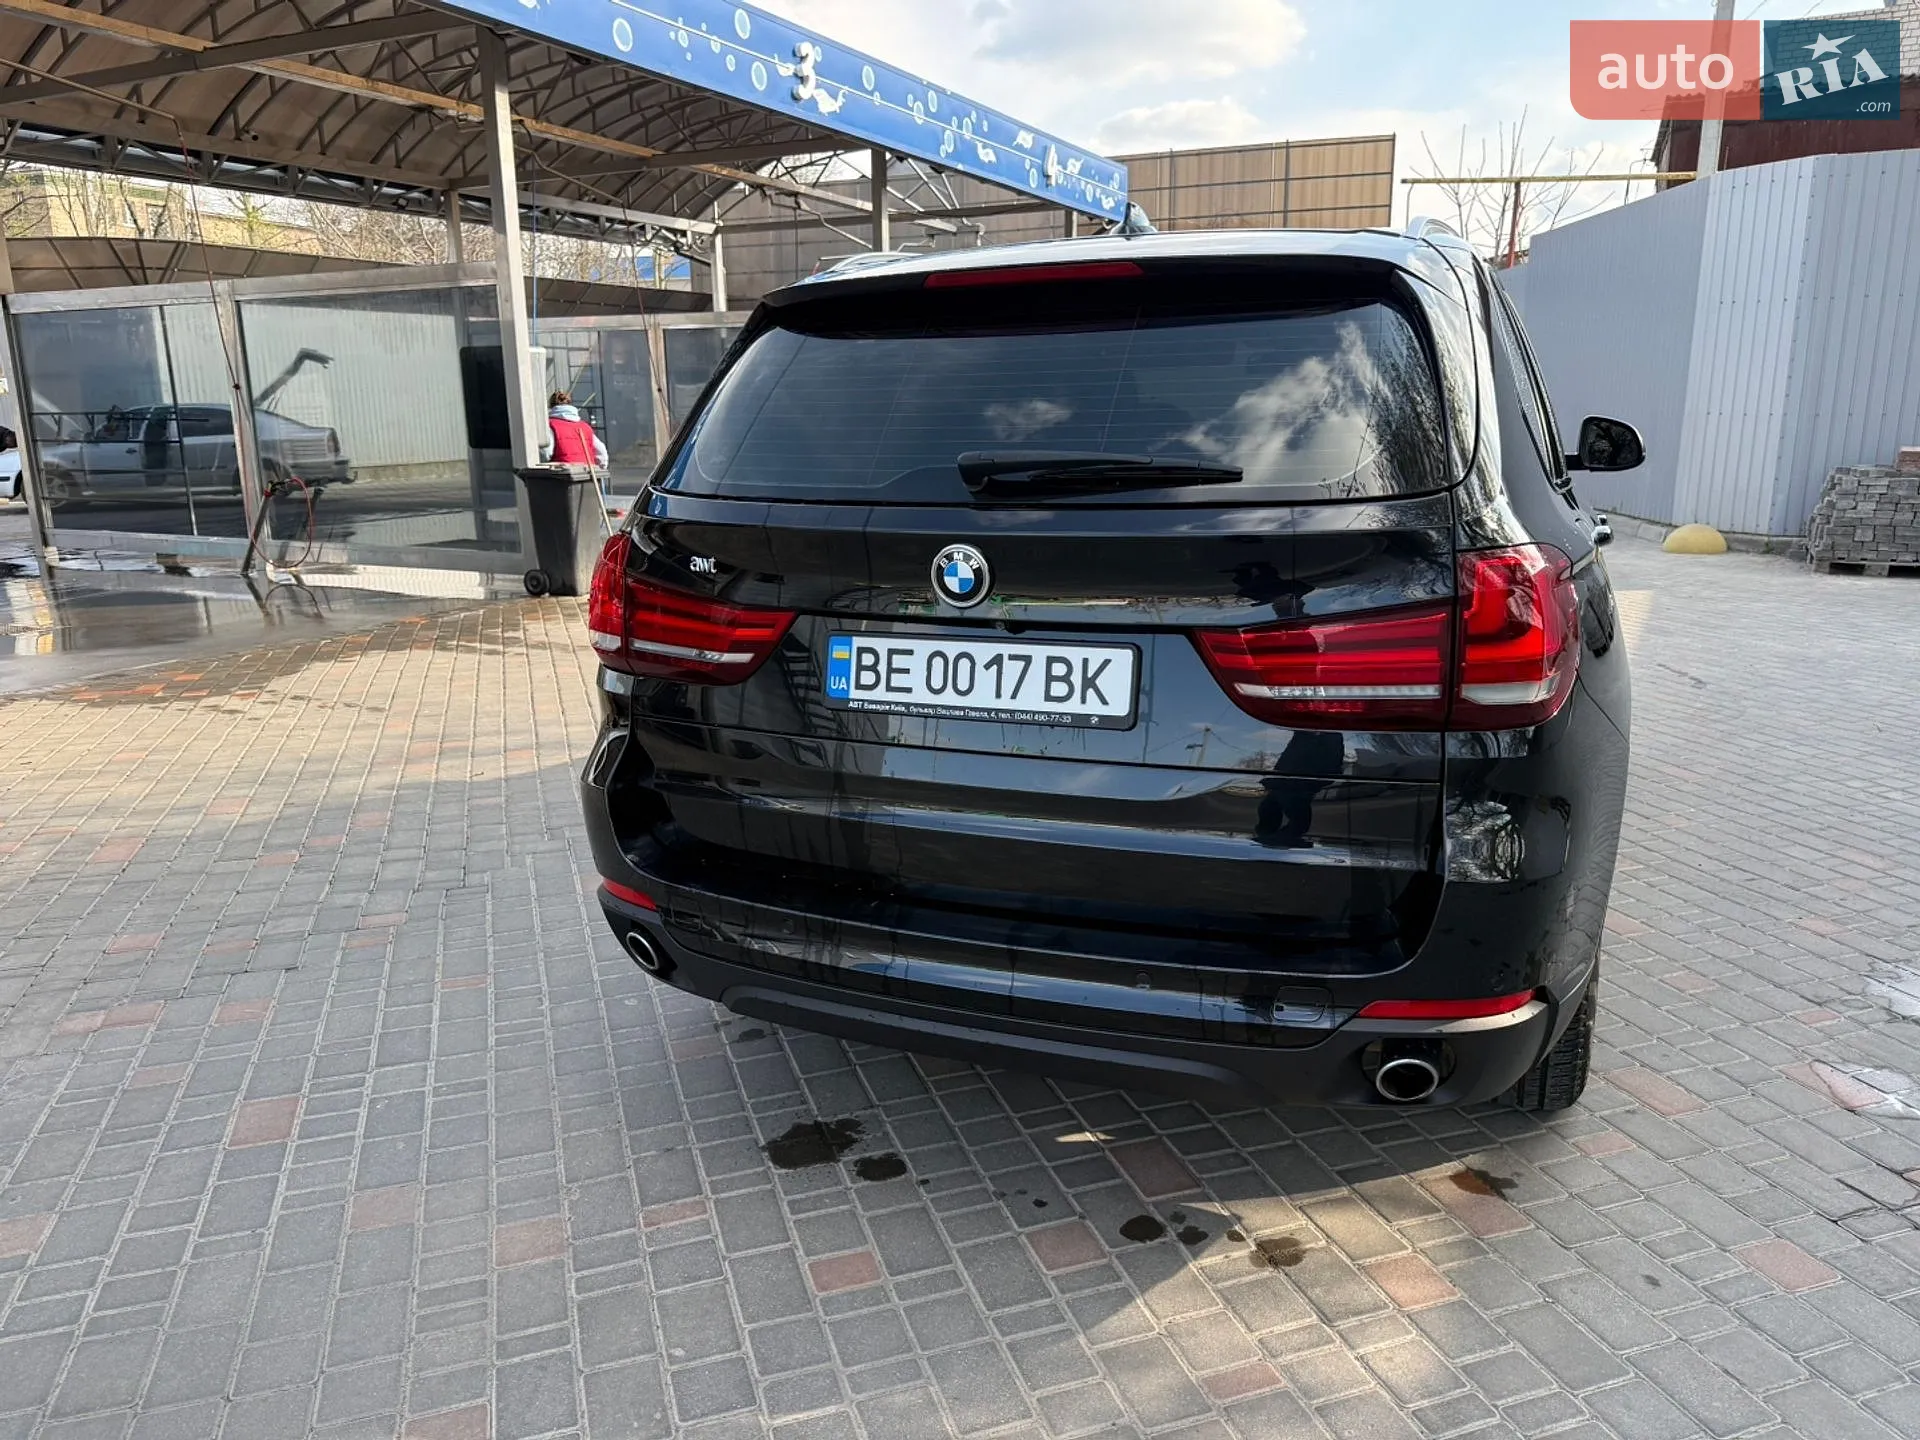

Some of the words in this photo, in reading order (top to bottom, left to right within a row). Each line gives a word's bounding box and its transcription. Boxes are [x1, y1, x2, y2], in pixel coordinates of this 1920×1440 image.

[793, 41, 816, 101] 3
[1044, 143, 1060, 188] 4
[940, 552, 980, 570] BMW
[830, 675, 848, 690] UA
[855, 646, 914, 693] BE
[926, 650, 1033, 700] 0017
[1044, 655, 1113, 706] BK
